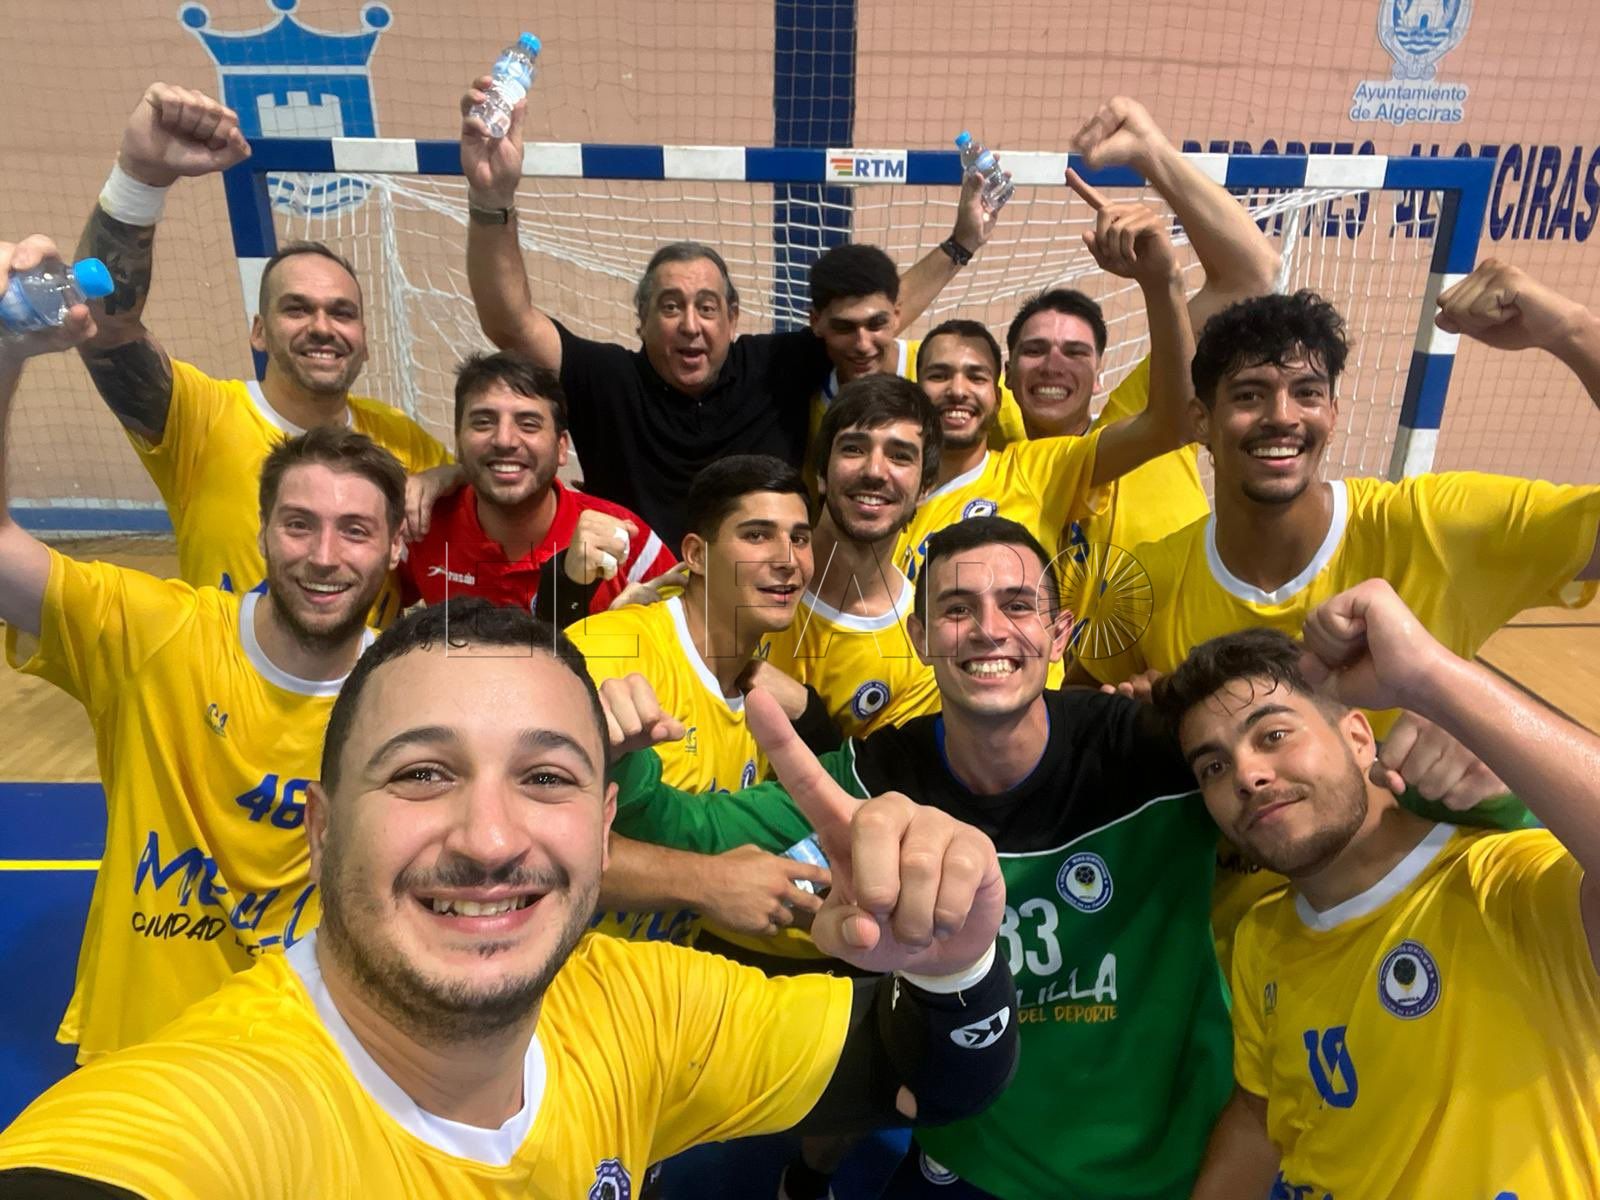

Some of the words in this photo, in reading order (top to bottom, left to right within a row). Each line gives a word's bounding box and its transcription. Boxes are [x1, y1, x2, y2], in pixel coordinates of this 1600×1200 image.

[1355, 83, 1467, 102] Ayuntamiento
[1350, 107, 1371, 120] de
[1375, 102, 1463, 124] Algeciras
[855, 158, 904, 178] RTM
[1389, 142, 1600, 243] ALCIRAS
[132, 911, 227, 941] CIUDAD
[1015, 952, 1118, 1009] LILLA
[1017, 1007, 1047, 1024] DEL
[1054, 1003, 1118, 1024] DEPORTE
